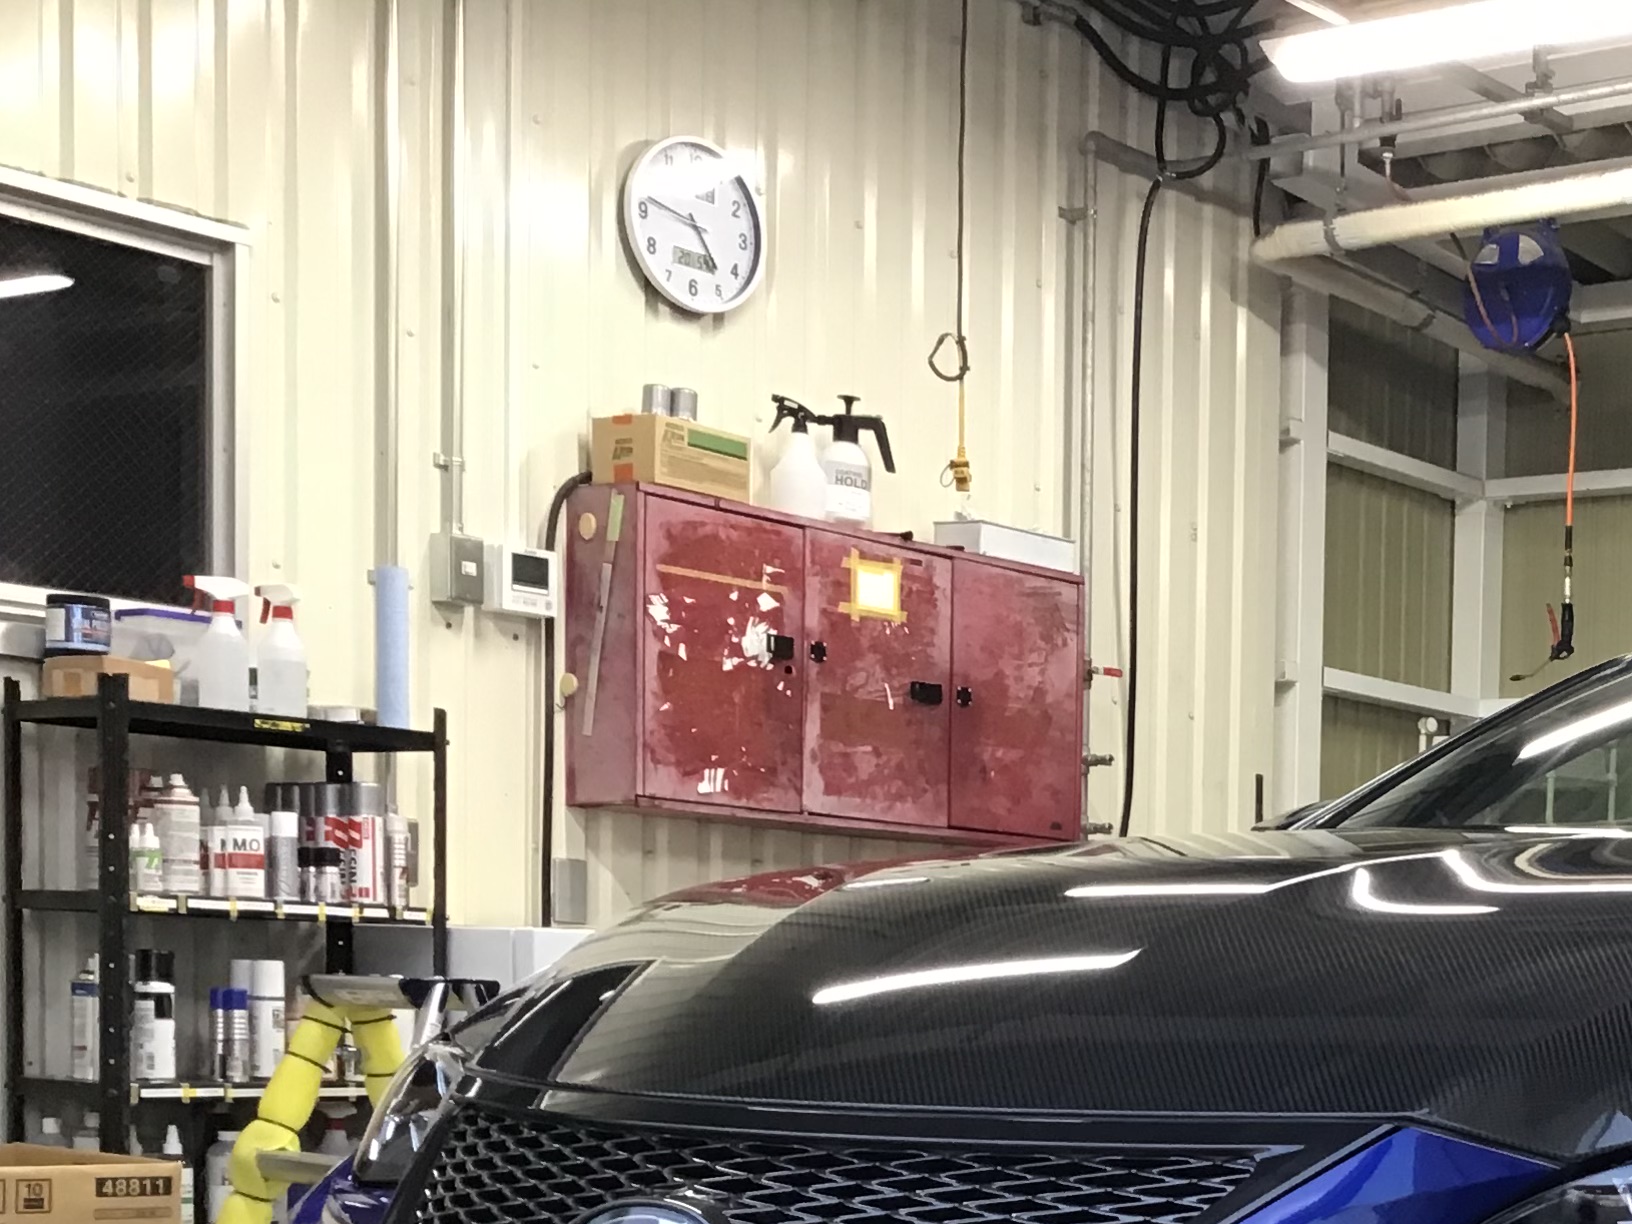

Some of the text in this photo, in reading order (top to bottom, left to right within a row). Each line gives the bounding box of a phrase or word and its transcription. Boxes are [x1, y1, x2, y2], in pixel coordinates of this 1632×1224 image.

[638, 200, 648, 219] 9
[731, 200, 741, 218] 2
[646, 237, 656, 255] 8
[738, 233, 748, 250] 3
[665, 269, 672, 282] 7
[730, 263, 739, 280] 4
[688, 279, 698, 297] 6
[715, 284, 722, 297] 5
[835, 475, 868, 490] HOLD
[102, 1178, 165, 1197] 48811
